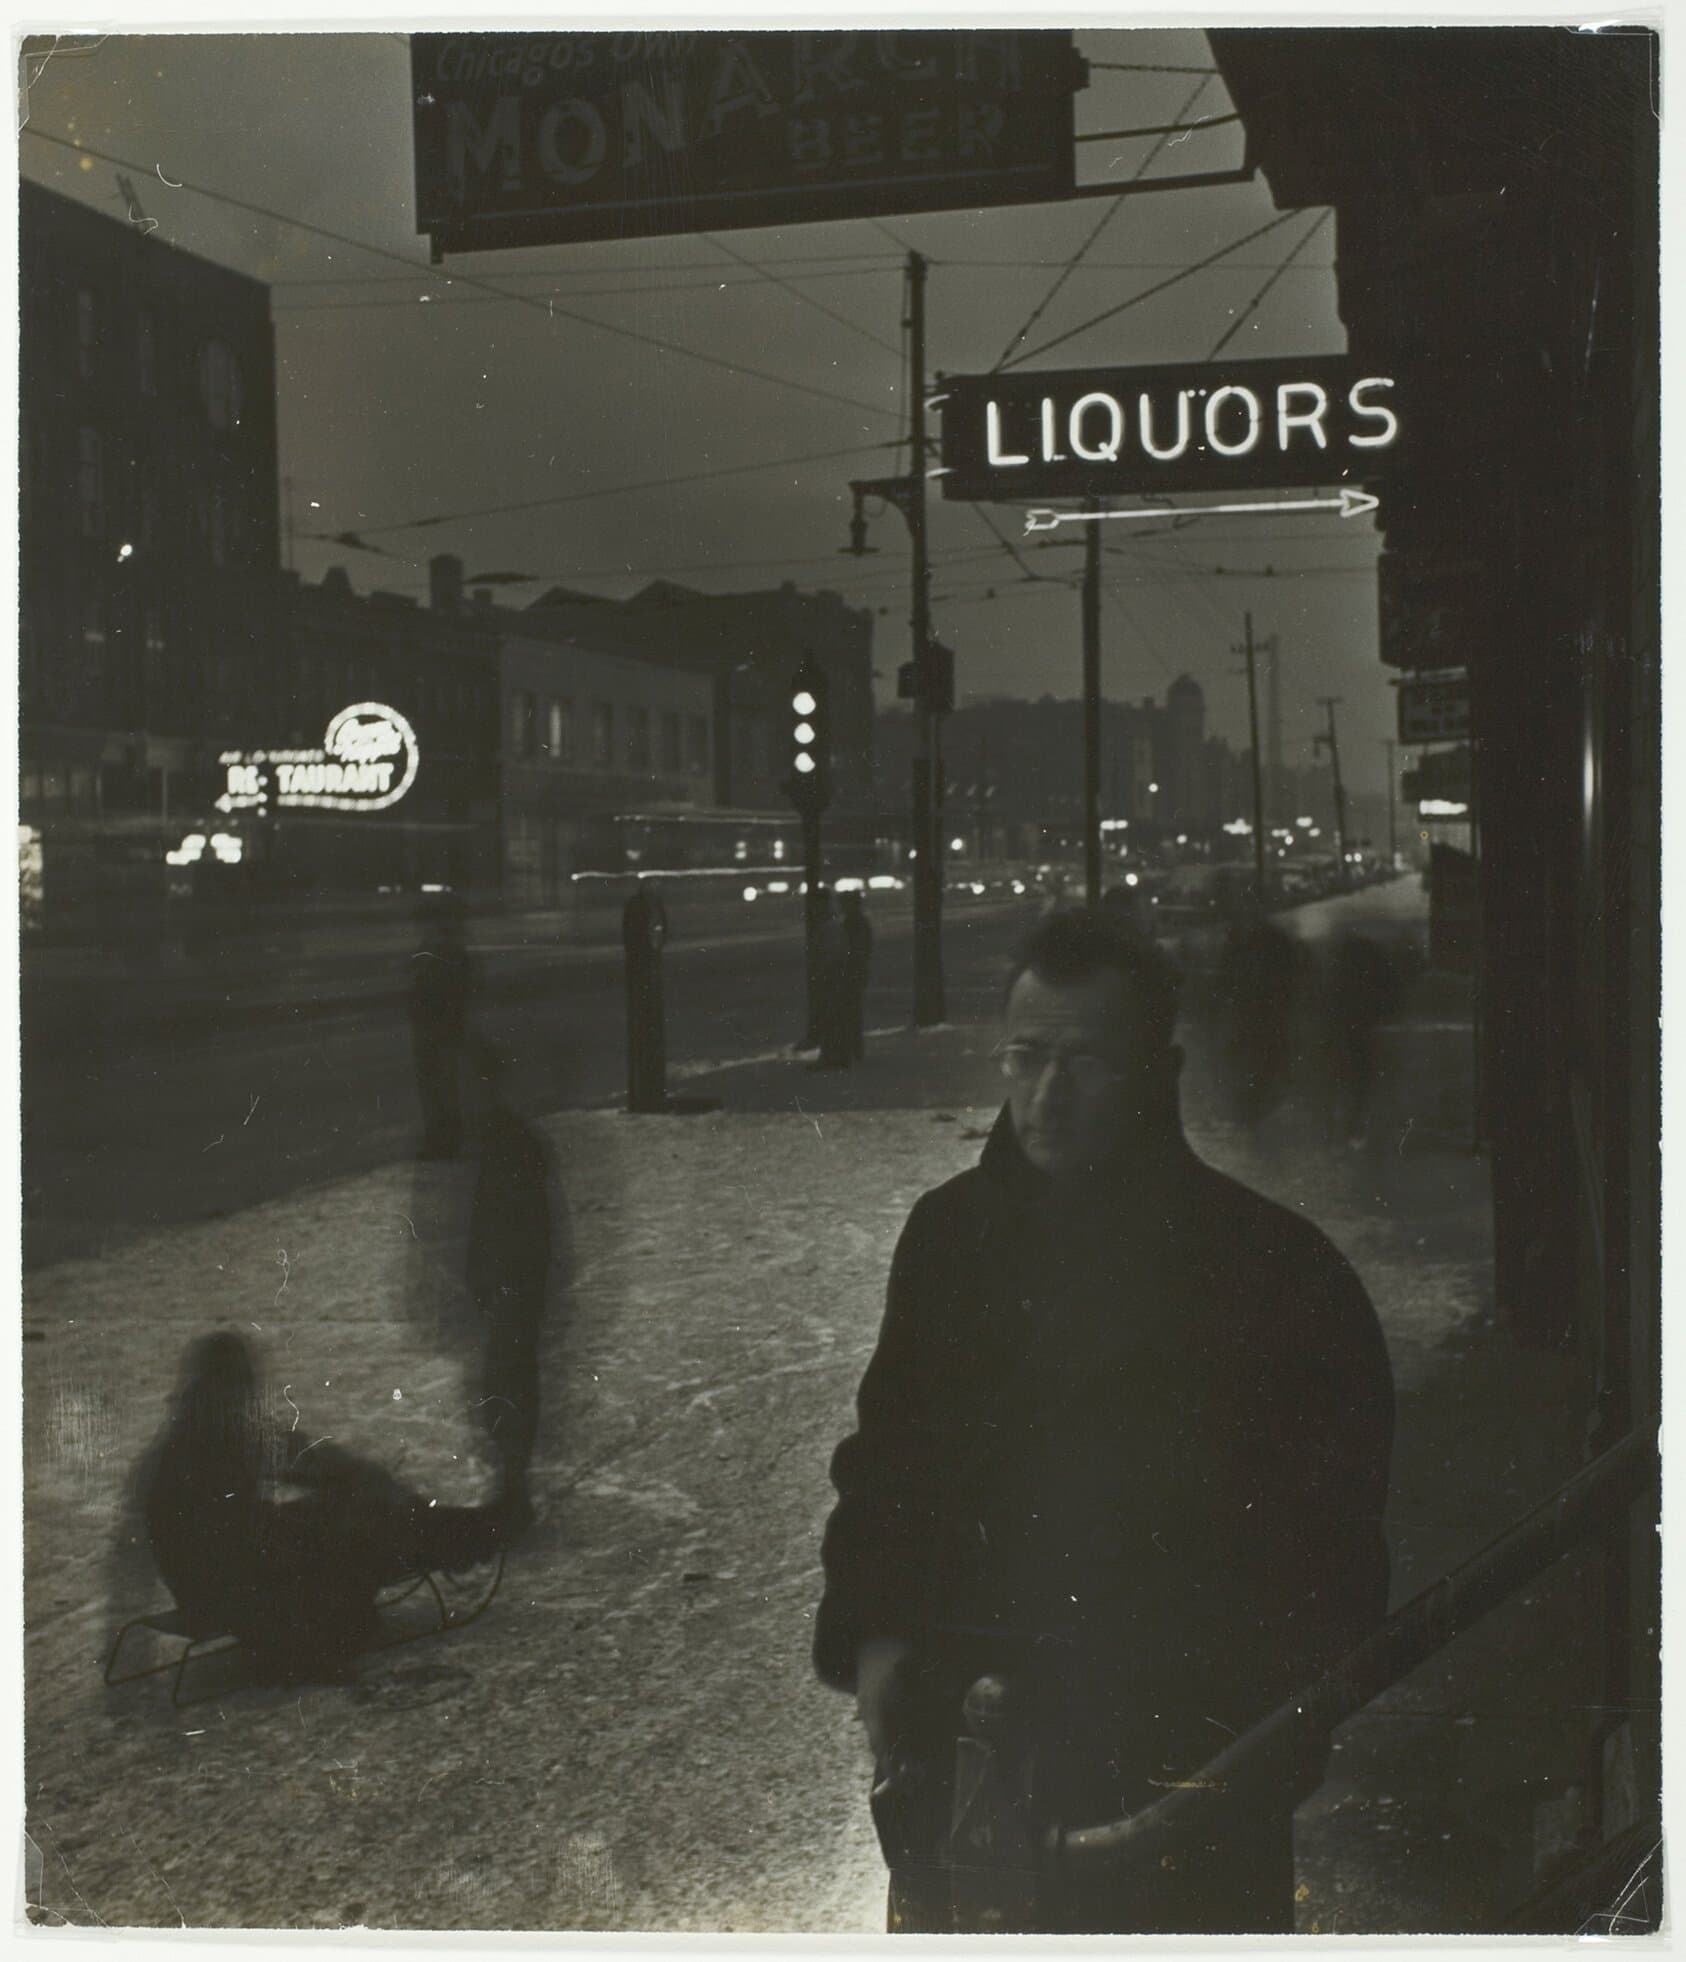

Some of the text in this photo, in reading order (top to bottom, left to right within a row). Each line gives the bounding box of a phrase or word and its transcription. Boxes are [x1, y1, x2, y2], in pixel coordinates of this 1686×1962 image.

[447, 32, 1021, 206] MONARCH
[787, 103, 1004, 167] BEER
[986, 376, 1398, 467] LIQUORS
[228, 762, 394, 794] RETAURANT
